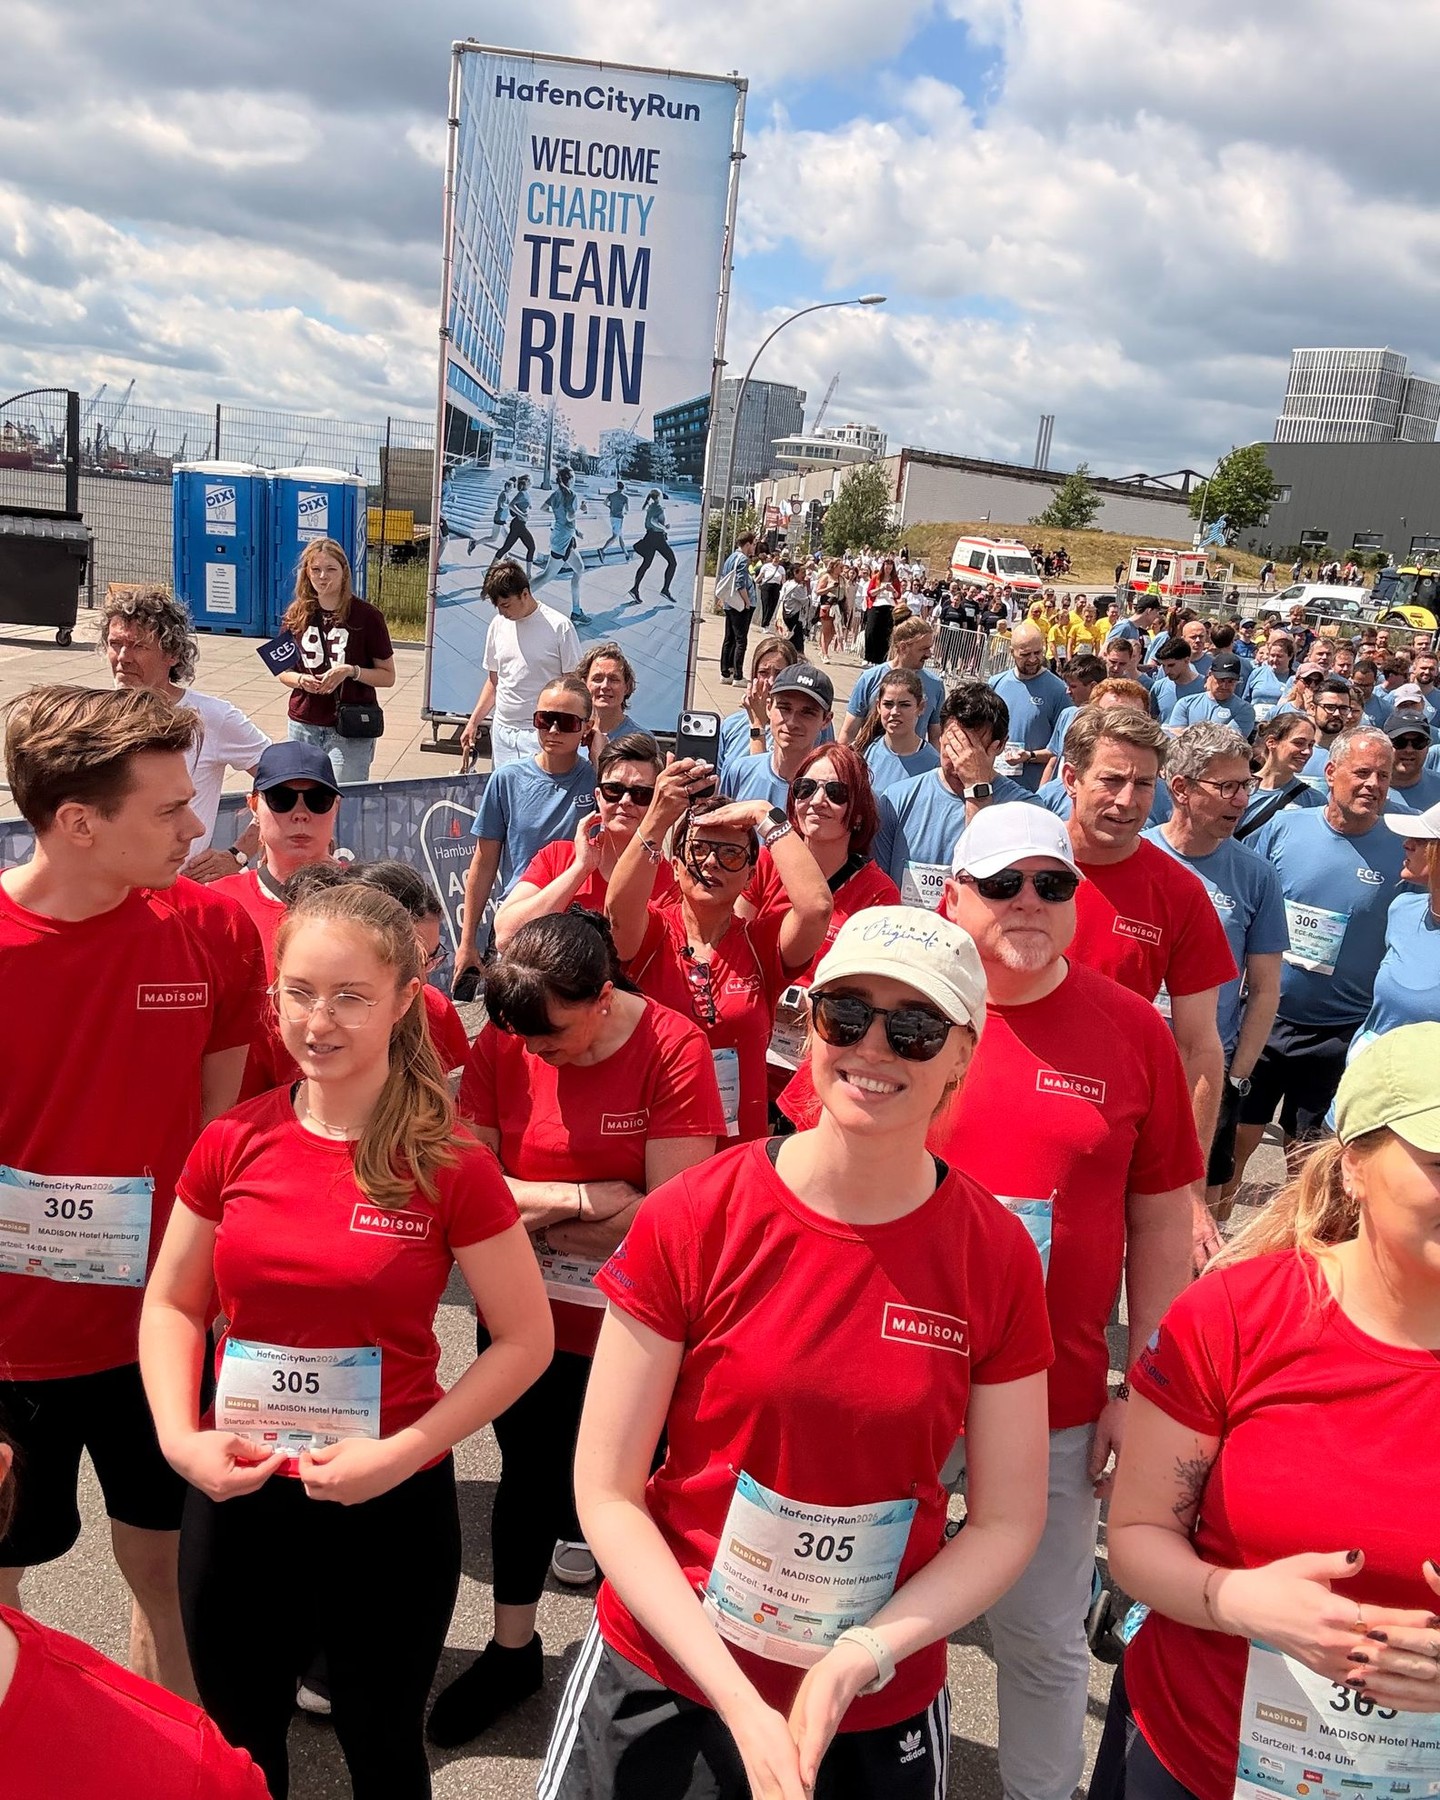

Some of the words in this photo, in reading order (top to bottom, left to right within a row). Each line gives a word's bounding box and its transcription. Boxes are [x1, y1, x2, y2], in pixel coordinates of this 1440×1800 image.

[495, 75, 700, 121] HafenCityRun
[531, 135, 660, 185] WELCOME
[527, 182, 655, 236] CHARITY
[523, 234, 651, 310] TEAM
[517, 307, 646, 405] RUN
[206, 488, 236, 507] DIXI
[299, 496, 328, 515] DIXI
[269, 641, 292, 662] ECE
[300, 625, 350, 669] 93
[796, 675, 814, 687] HH
[573, 793, 593, 804] ECE
[434, 844, 477, 860] Hambur
[921, 874, 944, 887] 306
[1356, 867, 1381, 881] ECE
[1208, 891, 1232, 906] ECE
[1118, 922, 1157, 940] MADISON
[1294, 914, 1319, 929] 306
[1294, 928, 1334, 943] ECE-Runners
[144, 991, 203, 1002] MADISON
[1043, 1077, 1099, 1096] MADISON
[607, 1118, 644, 1129] MADISO
[44, 1197, 94, 1220] 305
[359, 1213, 424, 1233] MADISON
[38, 1227, 78, 1238] MADISON
[79, 1230, 101, 1239] Hotel
[102, 1233, 140, 1242] Hamburg
[0, 1240, 24, 1249] artzeit:
[26, 1243, 47, 1252] 14:04
[892, 1317, 964, 1344] MADISON
[271, 1369, 320, 1395] 305
[227, 1400, 257, 1408] MADISON
[267, 1403, 307, 1413] MADISON
[331, 1407, 370, 1417] Hamburg
[779, 1505, 879, 1527] HafenCityRun2026
[732, 1544, 769, 1568] MADISON
[794, 1532, 855, 1563] 305
[722, 1561, 760, 1588] Startzeit:
[762, 1583, 789, 1600] 14:04
[790, 1593, 810, 1604] Uhr
[780, 1567, 831, 1585] MADISON
[832, 1576, 858, 1586] Hotel
[859, 1571, 893, 1584] Hamburg
[1260, 1709, 1304, 1727] MADISON
[1319, 1724, 1376, 1744] MADISON
[1378, 1735, 1408, 1747] Hotel
[1411, 1738, 1440, 1750] Hamb
[900, 1746, 926, 1764] adidas
[1251, 1731, 1298, 1753] Startzeit:
[1301, 1746, 1332, 1761] 14:04
[1334, 1754, 1356, 1766] Uhr
